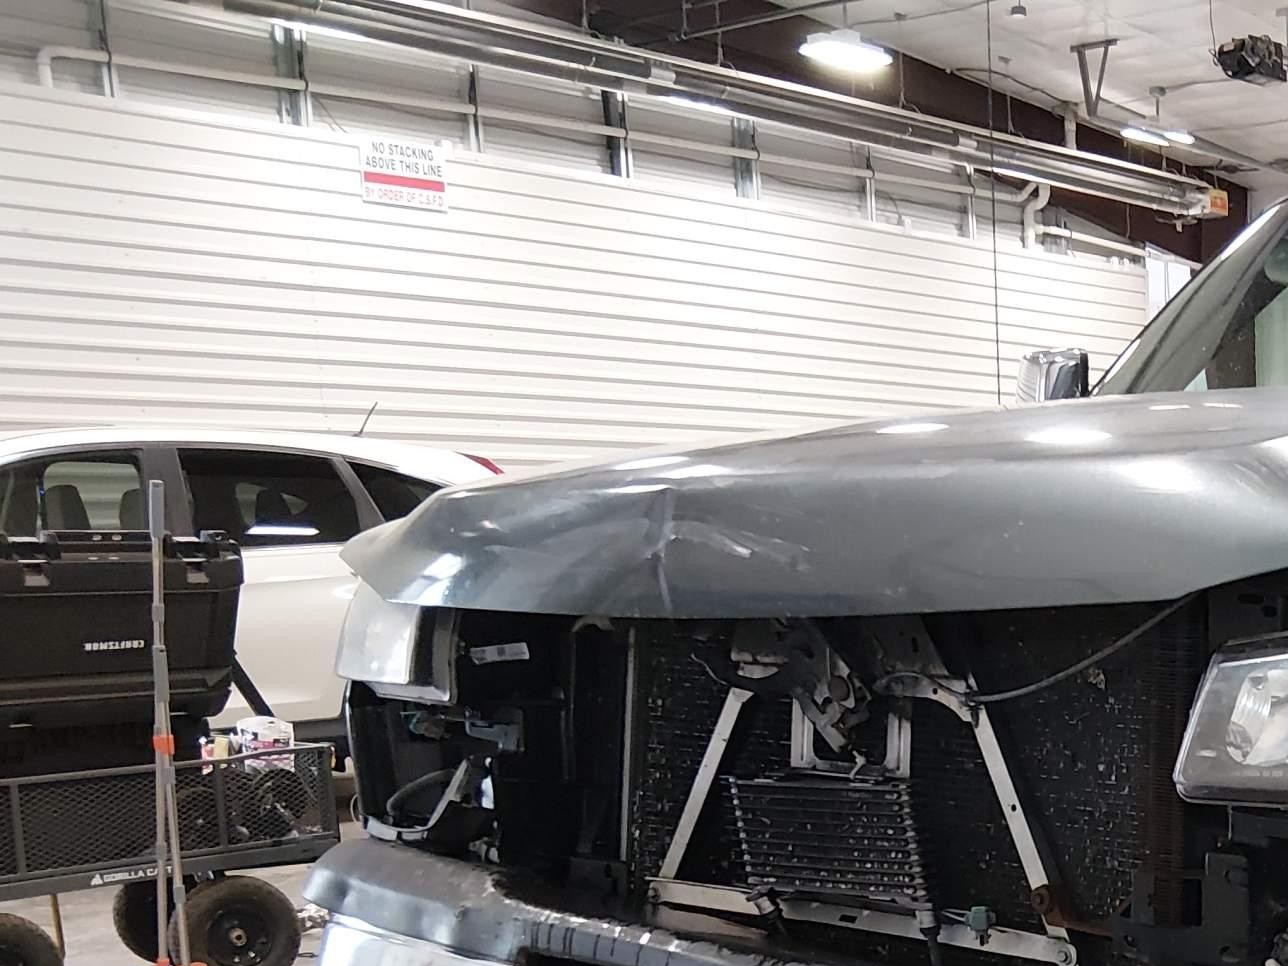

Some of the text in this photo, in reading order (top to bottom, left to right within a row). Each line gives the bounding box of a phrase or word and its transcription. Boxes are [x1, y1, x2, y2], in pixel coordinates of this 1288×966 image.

[372, 141, 434, 161] NO STACKING
[366, 156, 443, 178] ABOVE THIS LINE
[378, 188, 404, 201] ORDER
[406, 191, 416, 203] OF
[84, 640, 144, 651] CRAFTSMAN
[103, 866, 172, 882] GORILLA CAT
